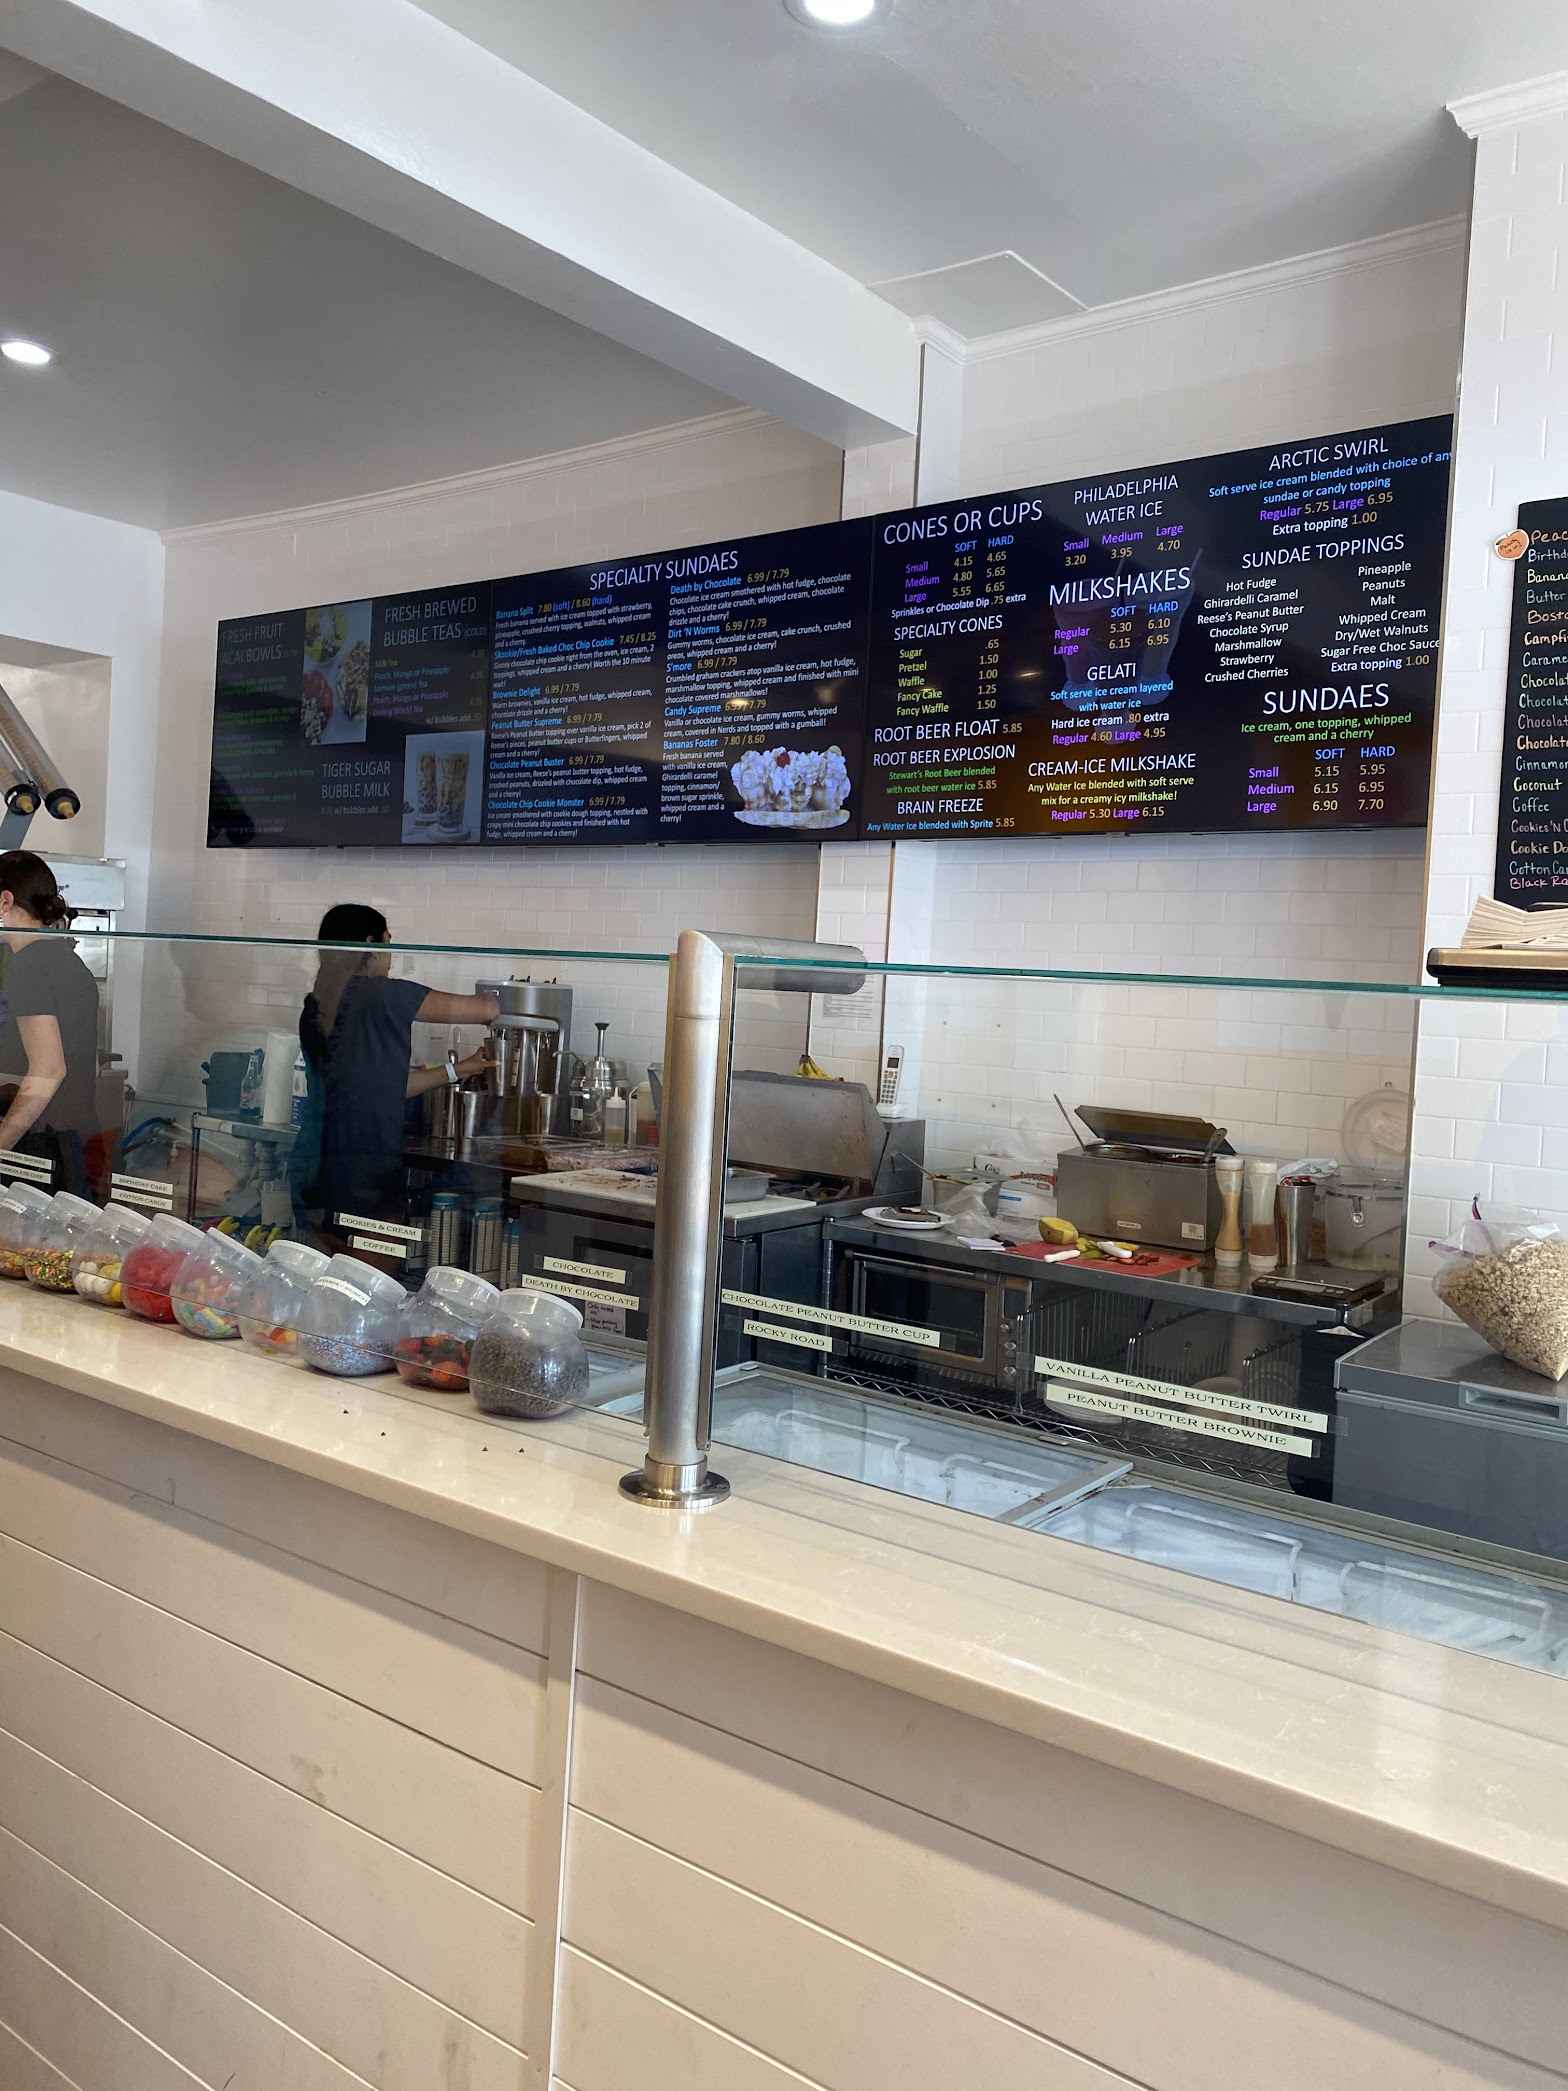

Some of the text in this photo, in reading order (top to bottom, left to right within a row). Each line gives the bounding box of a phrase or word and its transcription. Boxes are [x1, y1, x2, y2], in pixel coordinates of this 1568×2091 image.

[1269, 437, 1388, 471] ARCTIC SWIRL
[1074, 475, 1178, 505] PHILADELPHIA
[1086, 500, 1163, 526] WATER ICE
[1260, 491, 1393, 521] Regular 5.75 Large 6.95
[884, 500, 1042, 544] CONES OR CUPS
[1273, 511, 1377, 535] Extra topping 1.00
[955, 535, 1014, 553] SOFT HARD
[1063, 525, 1184, 551] Small Medium Large
[1242, 534, 1404, 569] SUNDAE TOPPINGS
[1528, 548, 1568, 563] Birthd
[590, 550, 738, 590] SPECIALTY SUNDAES
[906, 551, 1006, 574] Small 4.15 4.65
[1358, 561, 1411, 576] Pineapple
[670, 568, 789, 594] Death by Chocolate 6.99 / 7.79
[905, 566, 1006, 588] Medium 4.80 5.65
[1049, 567, 1190, 606] MILKSHAKES
[1226, 577, 1277, 592] Hot Fudge
[1362, 579, 1405, 592] Peanuts
[904, 581, 1005, 603] Large 5.55 6.65
[1204, 589, 1298, 609] Ghirardelli Caramel
[1371, 594, 1396, 606] Malt
[384, 596, 477, 624] FRESH BREWED
[891, 594, 1026, 619] Sprinkles or Chocolate Dip .75 extra
[222, 622, 284, 645] FRESH FRUIT
[383, 622, 461, 647] BUBBLE TEAS
[894, 615, 1003, 641] SPECIALTY CONES
[1524, 629, 1568, 646] Campfi
[220, 648, 244, 665] ACAI
[246, 644, 282, 664] BOWLS
[1215, 638, 1282, 652] Marshmallow
[899, 654, 999, 673] Pretzel 1.50
[1220, 654, 1274, 666] Strawberry
[1087, 663, 1136, 681] GELATI
[1263, 683, 1389, 714] SUNDAES
[664, 705, 721, 716] Candy Supreme
[875, 719, 1022, 742] ROOT BEER FLOAT 5.85
[663, 738, 718, 749] Bananas Foster
[1315, 746, 1395, 760] SOFT HARD
[873, 744, 1015, 766] ROOT BEER EXPLOSION
[1028, 753, 1196, 776] CREAM-ICE MILKSHAKE
[321, 763, 351, 777] TIGER
[354, 760, 391, 776] SUGAR
[1249, 764, 1385, 778] Small 5.15 5.95
[321, 782, 390, 799] BUBBLE MILK
[1248, 781, 1384, 795] Medium 6.15 6.95
[1513, 777, 1563, 792] Coconut
[898, 798, 983, 814] BRAIN FREEZE
[1051, 806, 1164, 822] Regular 5.30 Large 6.15
[1247, 799, 1384, 813] Large 6.90 7.70
[1512, 797, 1550, 813] Coffee
[1511, 819, 1549, 833] Cookies
[1510, 840, 1549, 854] Cookie
[1509, 861, 1550, 876] Cotton
[1509, 877, 1548, 890] Black
[119, 1178, 168, 1192] BIRTHDAY CAKE
[119, 1192, 167, 1207] COTTON CANDY
[341, 1217, 377, 1229] COOKIES
[386, 1225, 416, 1236] CREAM
[363, 1241, 396, 1253] COFFEE
[552, 1261, 613, 1279] CHOCOLATE
[525, 1277, 638, 1307] DEATH BY CHOCOLATE
[722, 1292, 930, 1341] CHOCOLATE PEANUT BUTTER CUP
[747, 1323, 825, 1347] ROCKY ROAD
[1046, 1362, 1313, 1424] VANILLA PEANUT BUTTER TWIRL
[1067, 1393, 1287, 1446] PEANUT BUTTER BROWNIE
